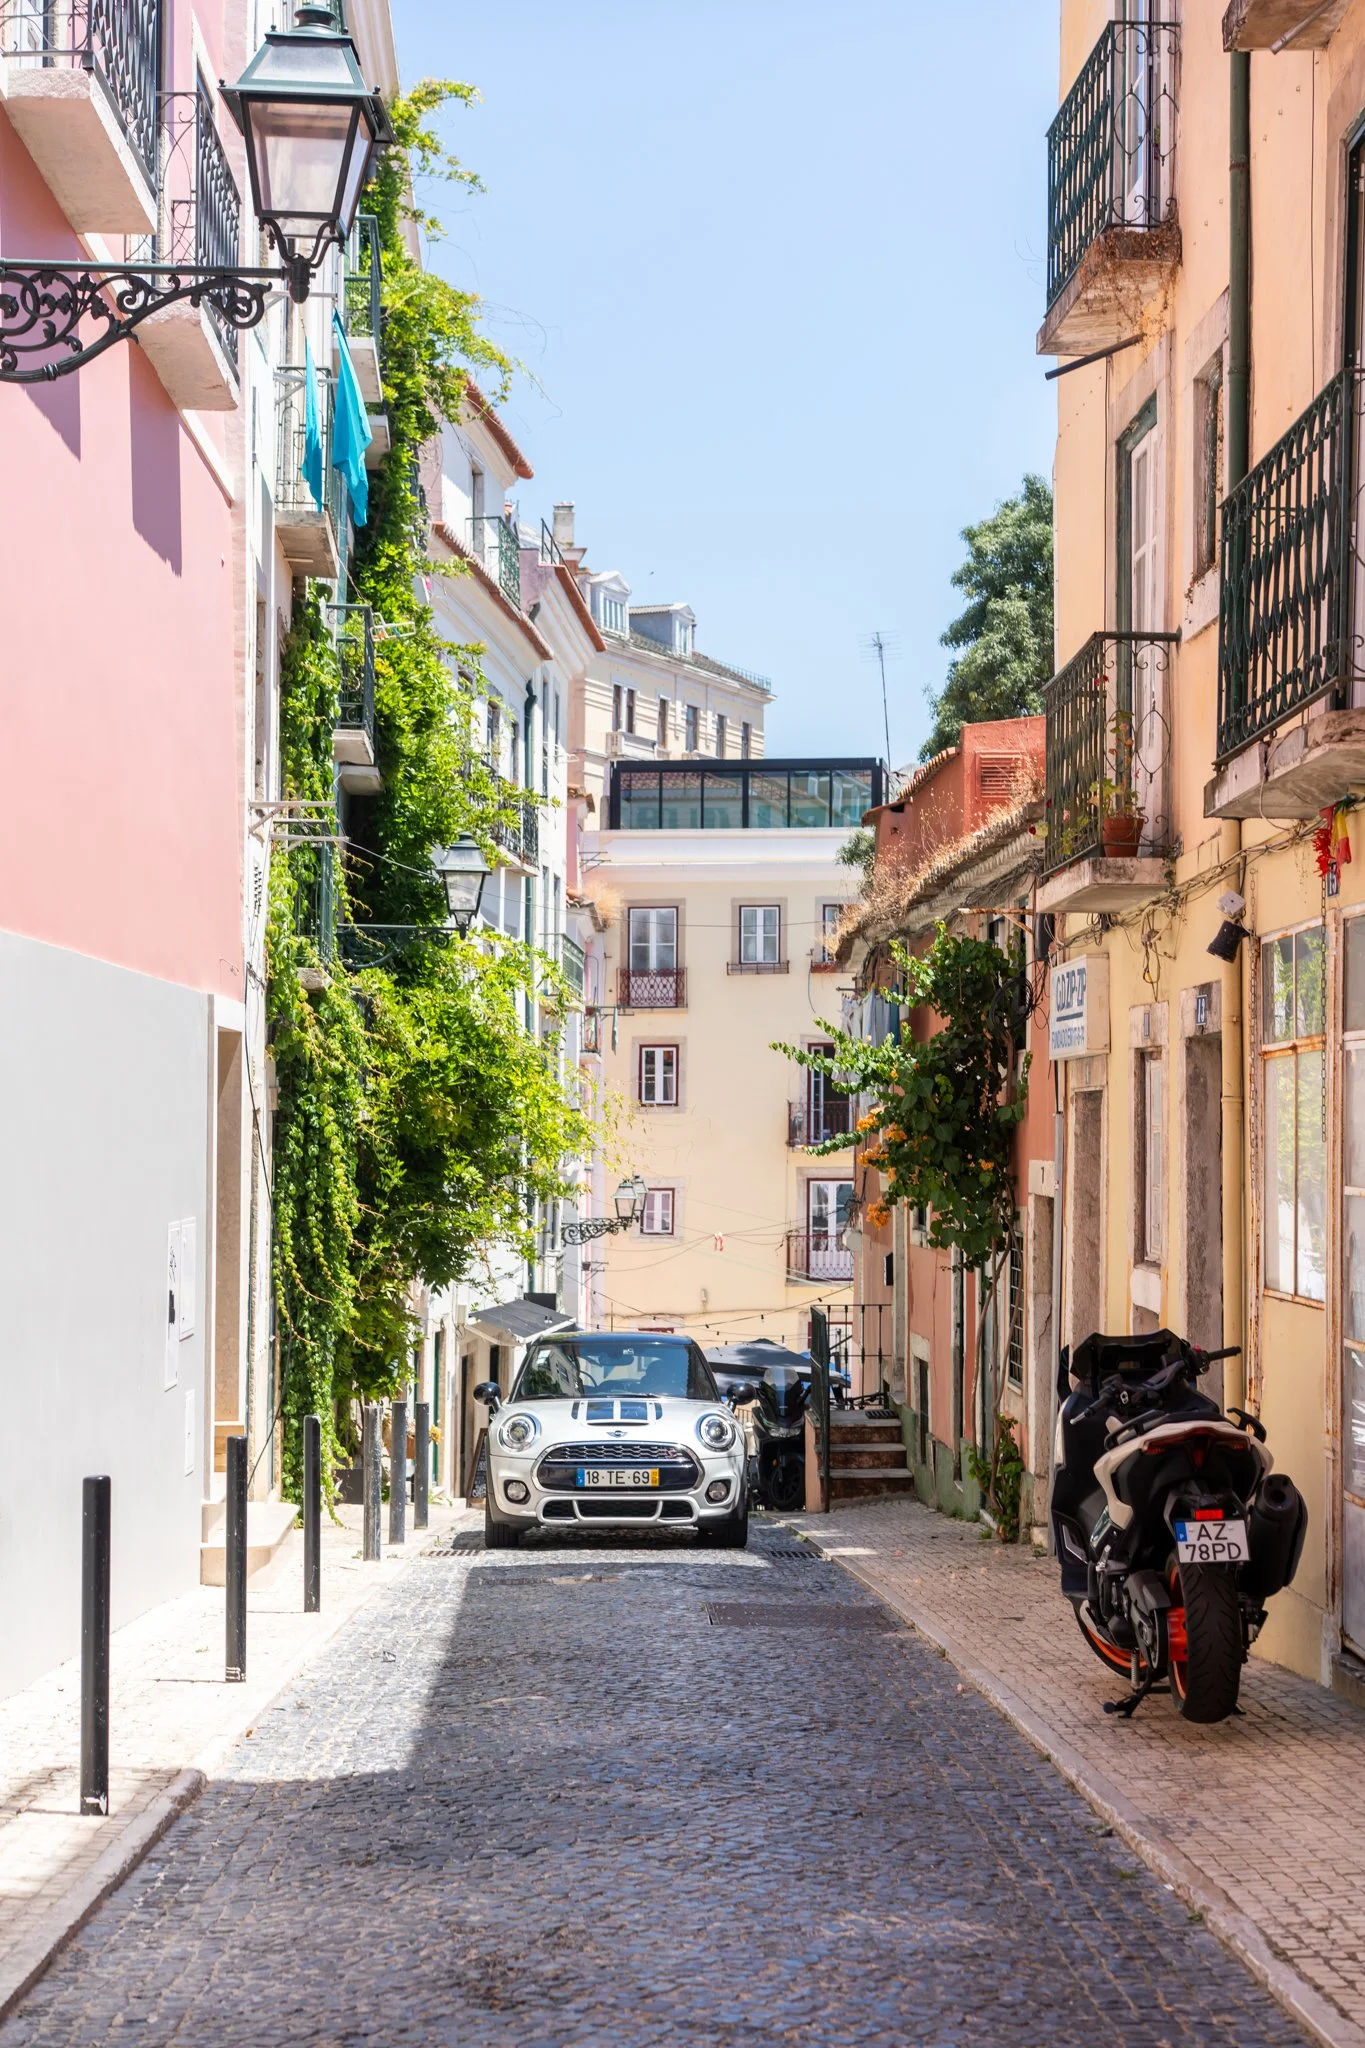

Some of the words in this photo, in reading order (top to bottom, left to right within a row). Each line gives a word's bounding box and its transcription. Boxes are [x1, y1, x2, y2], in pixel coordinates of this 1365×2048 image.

[1198, 998, 1205, 1022] 13
[1197, 1523, 1228, 1541] AZ
[1185, 1542, 1242, 1562] 78PD
